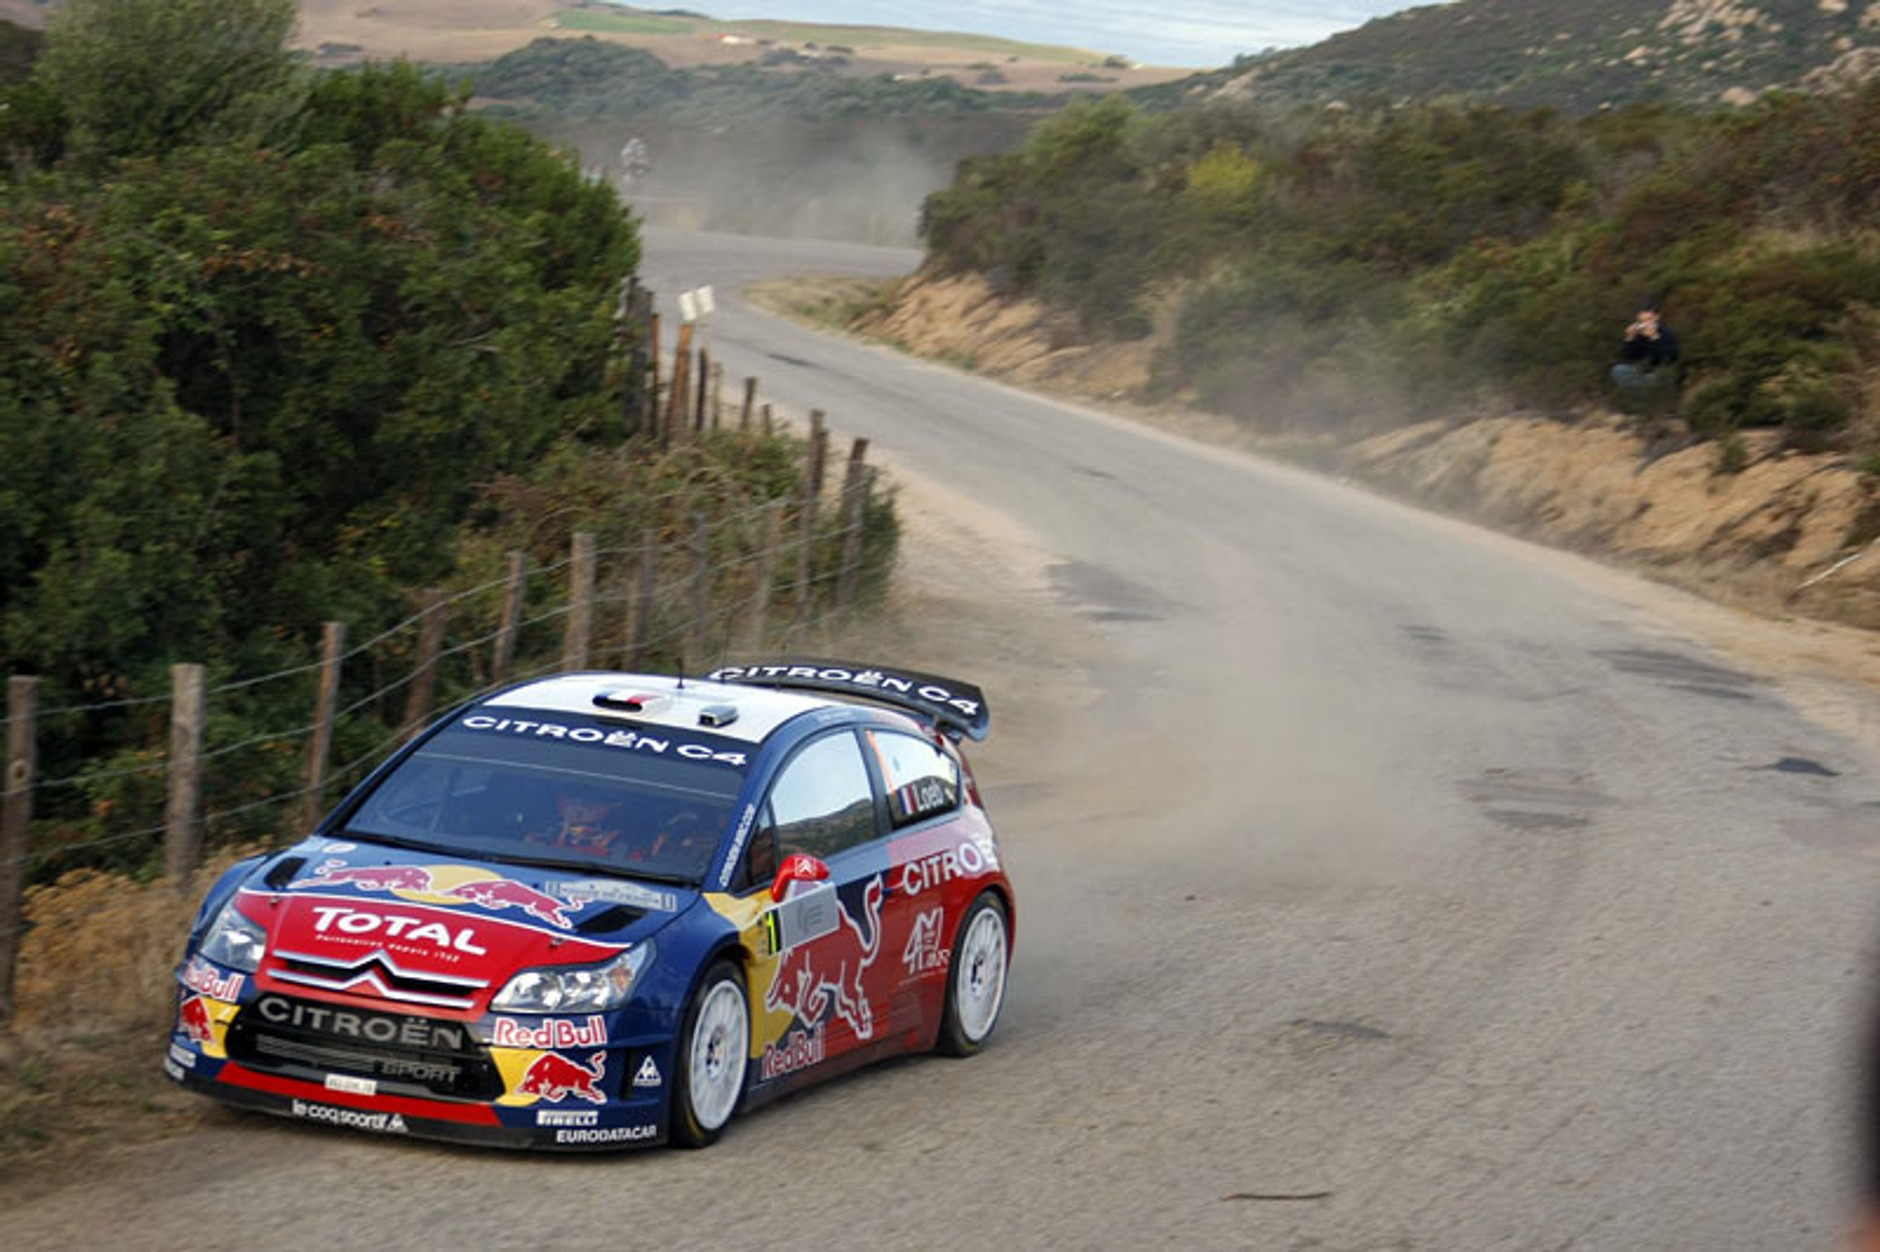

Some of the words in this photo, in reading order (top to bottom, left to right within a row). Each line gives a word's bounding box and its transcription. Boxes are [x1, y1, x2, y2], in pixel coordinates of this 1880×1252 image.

[708, 667, 913, 692] CITROËN
[918, 686, 979, 716] C4
[463, 716, 669, 753] CITROËN
[677, 744, 747, 766] C4
[313, 906, 487, 956] TOTAL
[258, 997, 463, 1049] CITROËN
[494, 1018, 553, 1047] Red
[556, 1015, 607, 1047] Bull
[557, 1125, 657, 1142] EURODATACAR
